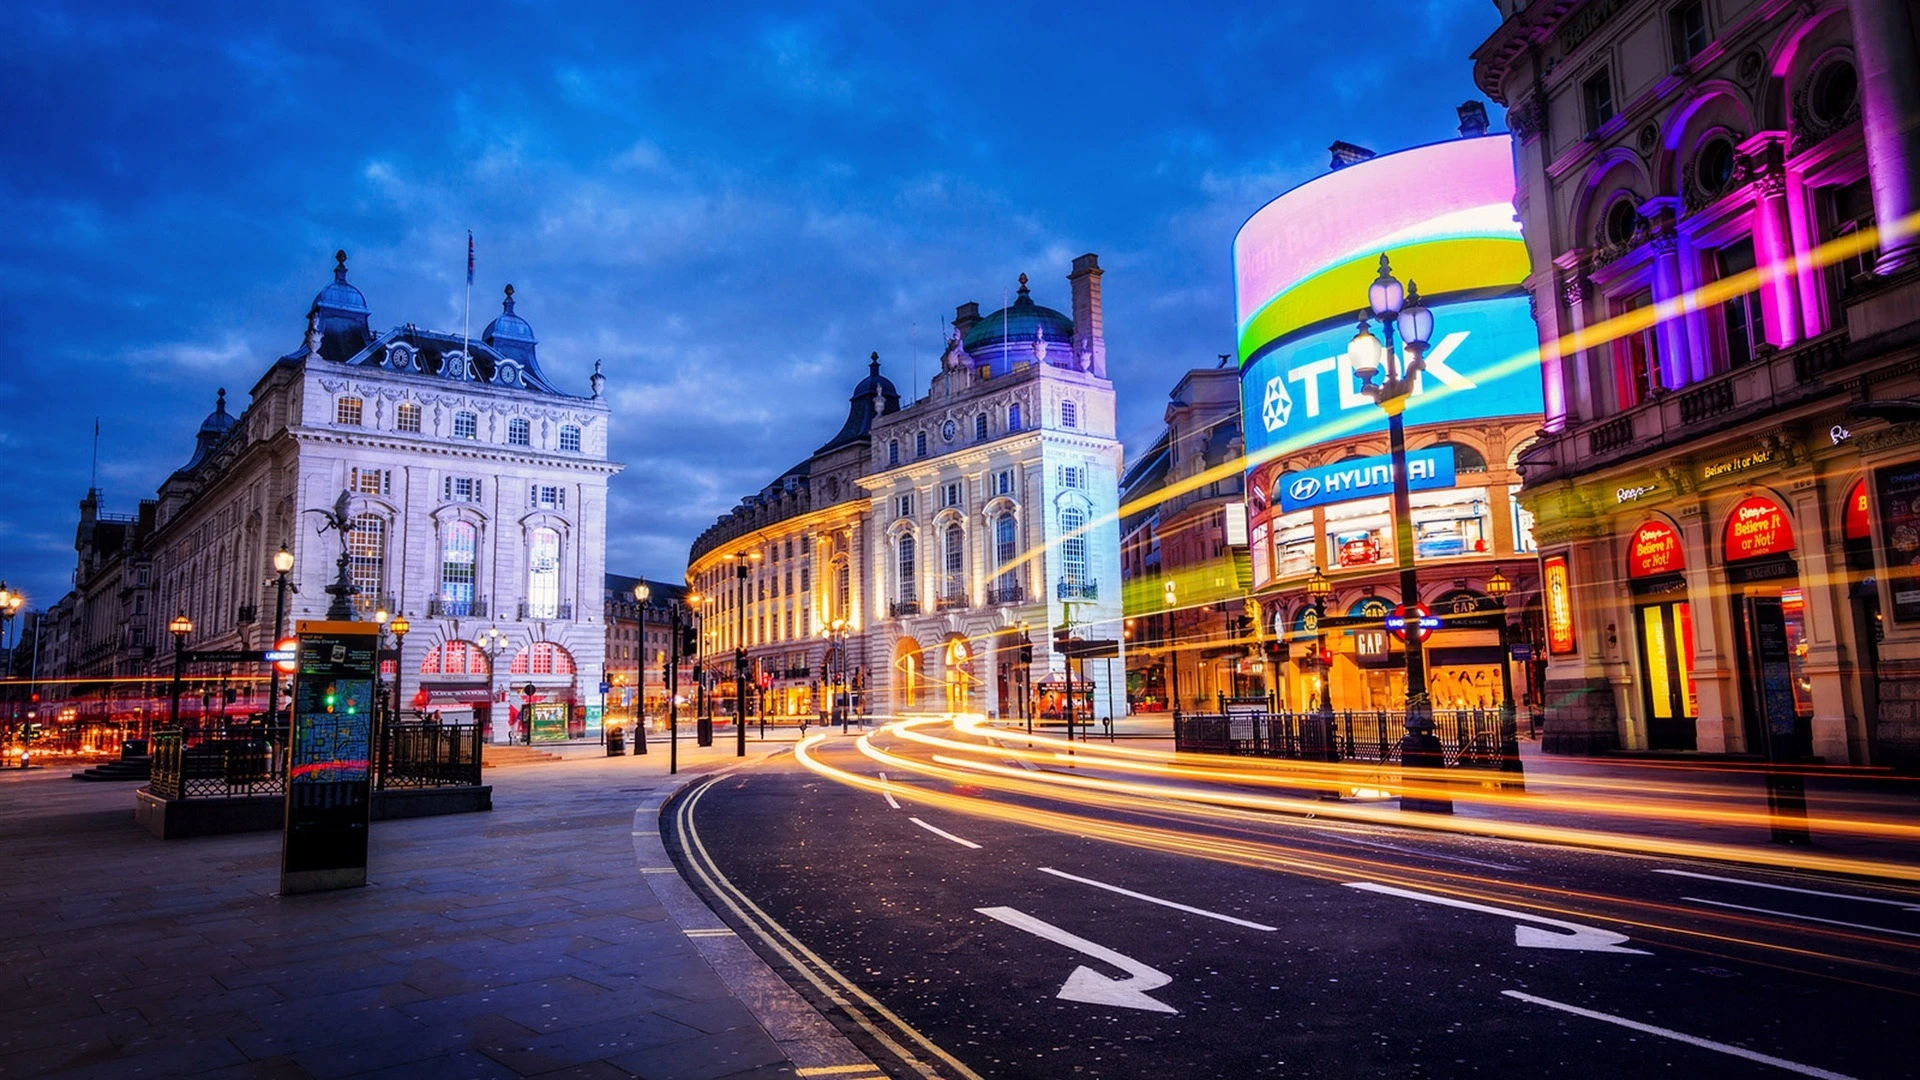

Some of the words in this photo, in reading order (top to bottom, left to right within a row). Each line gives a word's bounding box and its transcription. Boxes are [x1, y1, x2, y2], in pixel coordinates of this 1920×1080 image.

[1288, 331, 1477, 418] TDK
[1704, 462, 1732, 478] Believe
[1733, 458, 1741, 471] It
[1741, 457, 1750, 468] or
[1752, 450, 1771, 466] Not!
[1325, 459, 1435, 493] HYUNAI
[1734, 519, 1769, 536] Believe
[1771, 514, 1781, 528] It
[1636, 541, 1665, 556] Believe
[1666, 537, 1674, 550] It
[1742, 539, 1752, 550] or
[1754, 530, 1775, 549] Not!
[1642, 558, 1652, 569] or
[1652, 551, 1670, 567] Not!
[1453, 602, 1475, 613] GAP
[1388, 619, 1438, 627] UNDOUND
[1358, 633, 1382, 655] GAP
